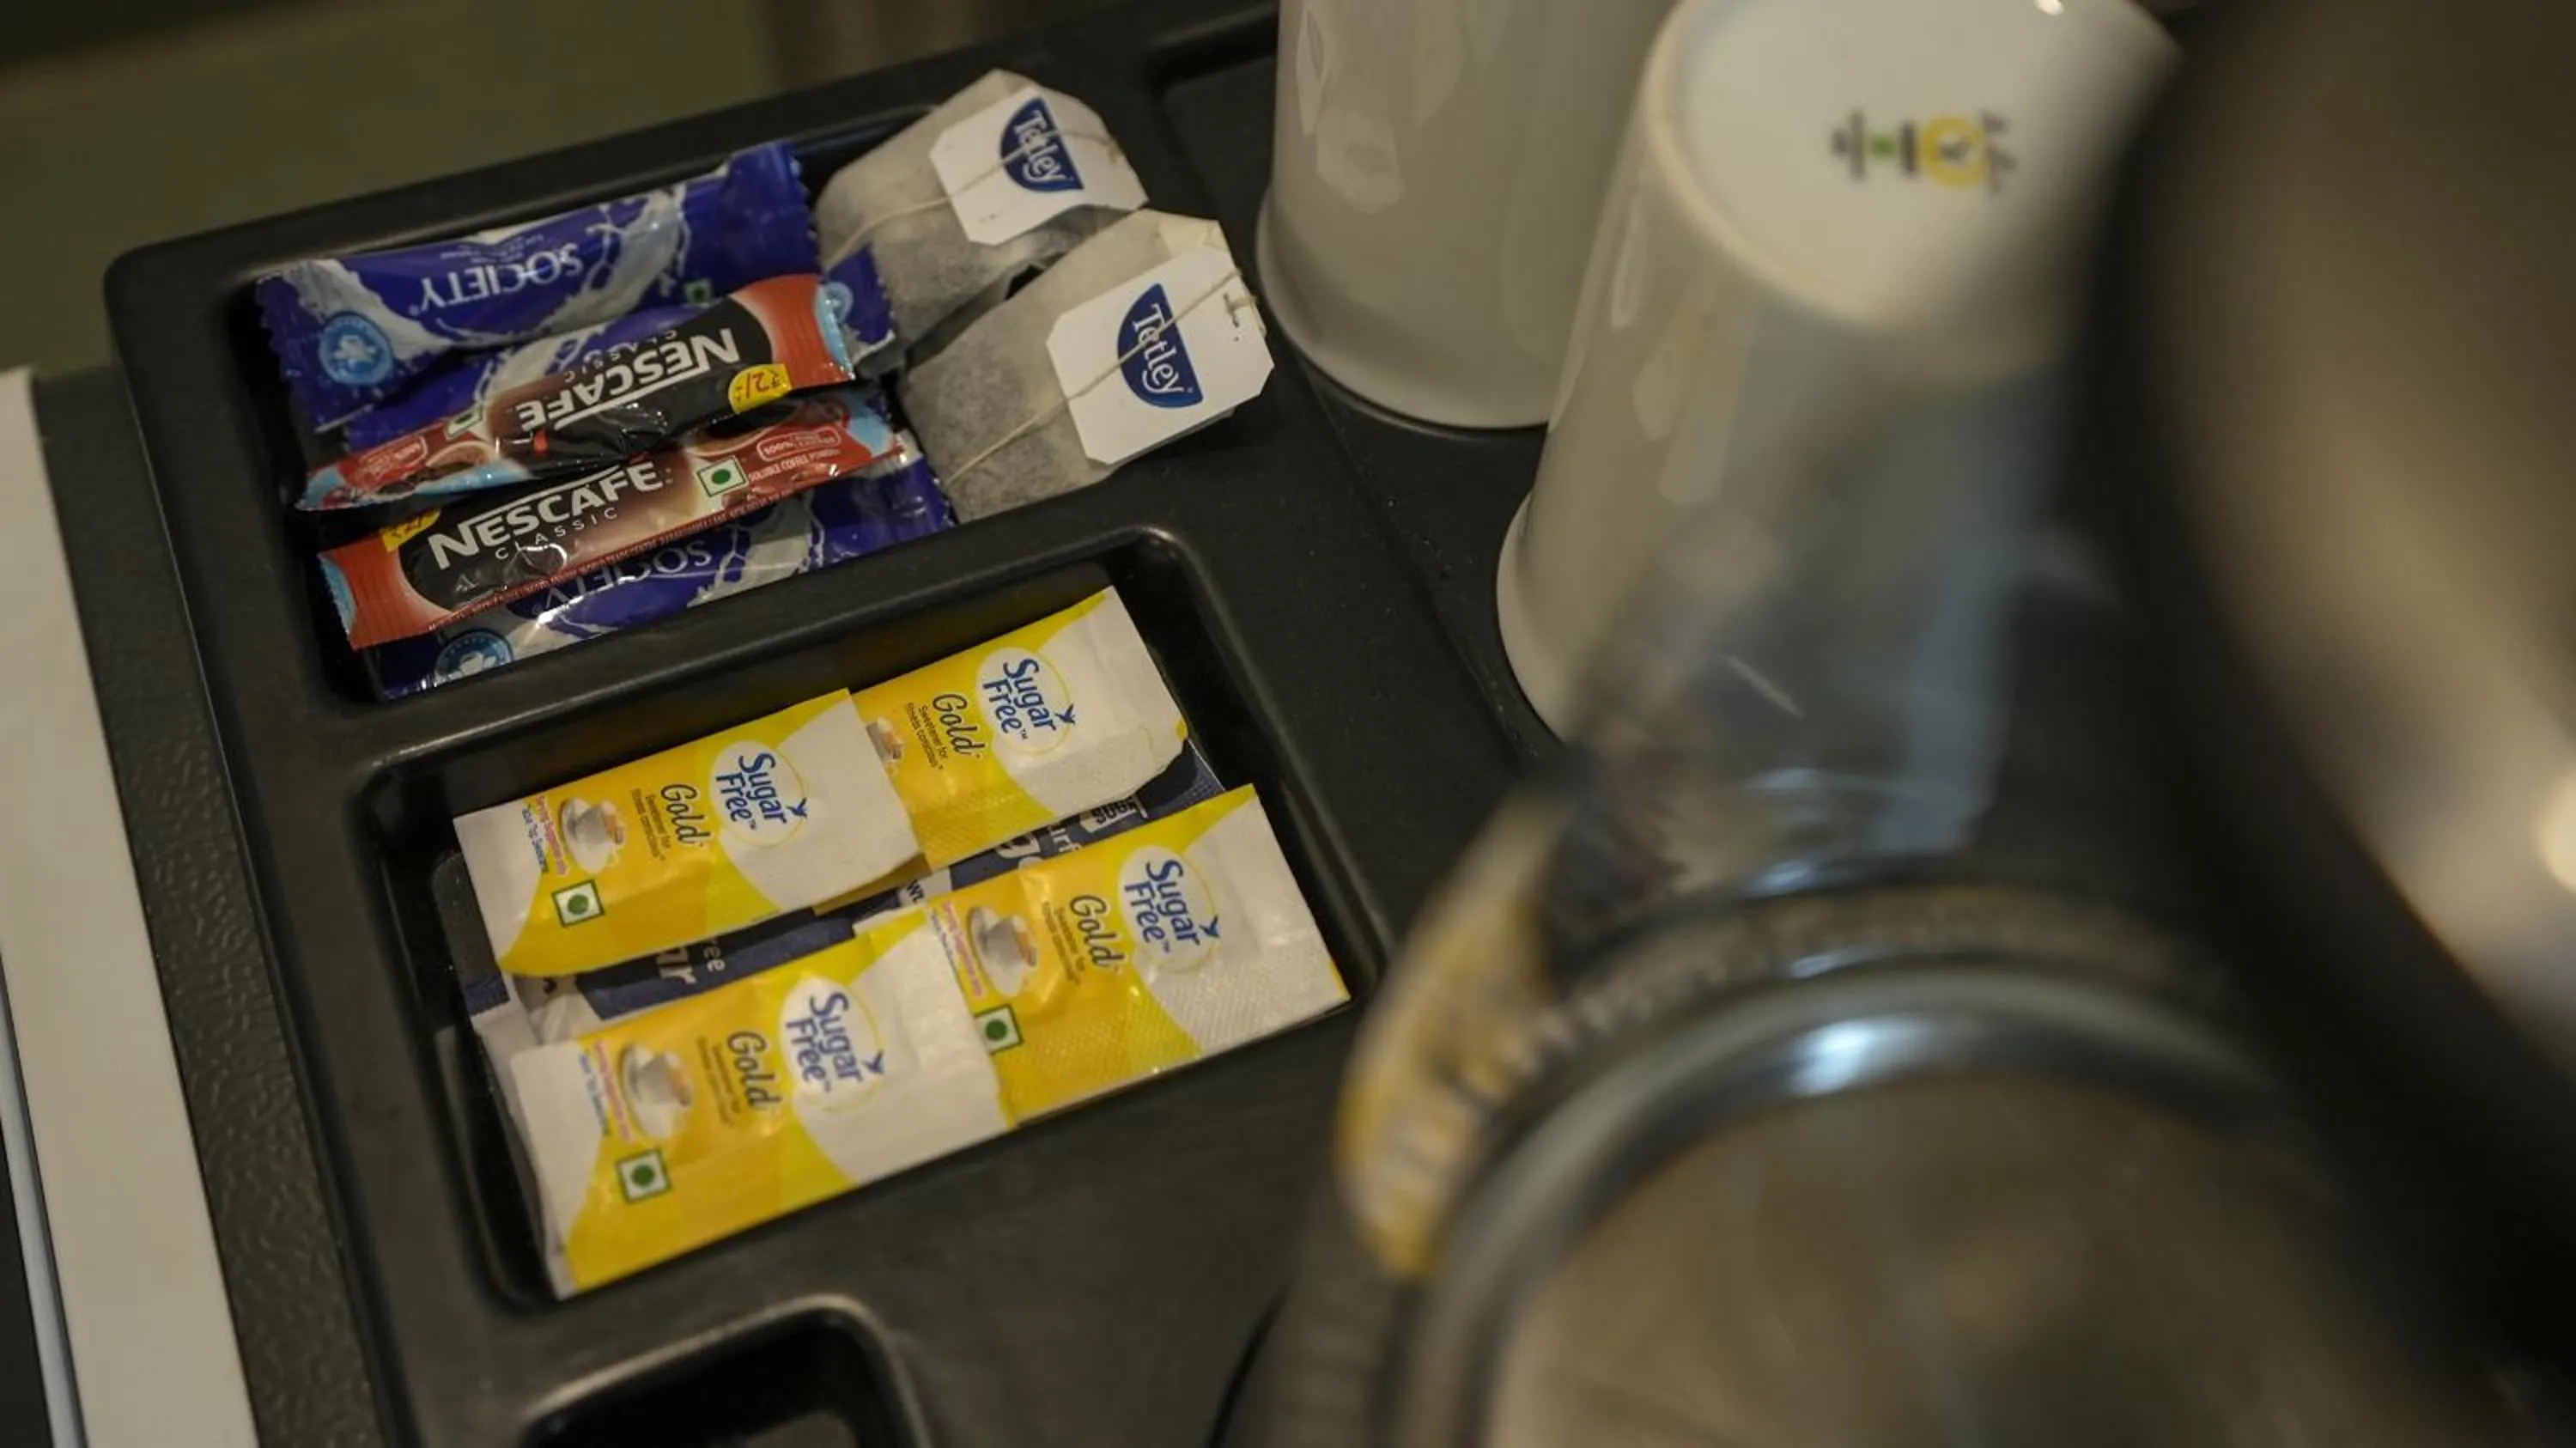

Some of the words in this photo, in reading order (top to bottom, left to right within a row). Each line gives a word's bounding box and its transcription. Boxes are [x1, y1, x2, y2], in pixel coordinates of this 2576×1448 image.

[421, 243, 584, 312] SOCIETY
[1133, 303, 1185, 393] Tetley
[495, 507, 618, 559] CLASSIC
[933, 694, 985, 755] Gold
[1003, 658, 1057, 731] Sugar
[661, 783, 713, 845] Gold
[739, 752, 788, 824] Sugar
[1070, 895, 1126, 968] Gold
[1146, 859, 1200, 946] Sugar
[727, 1031, 784, 1110] Gold
[810, 990, 863, 1084] Sugar
